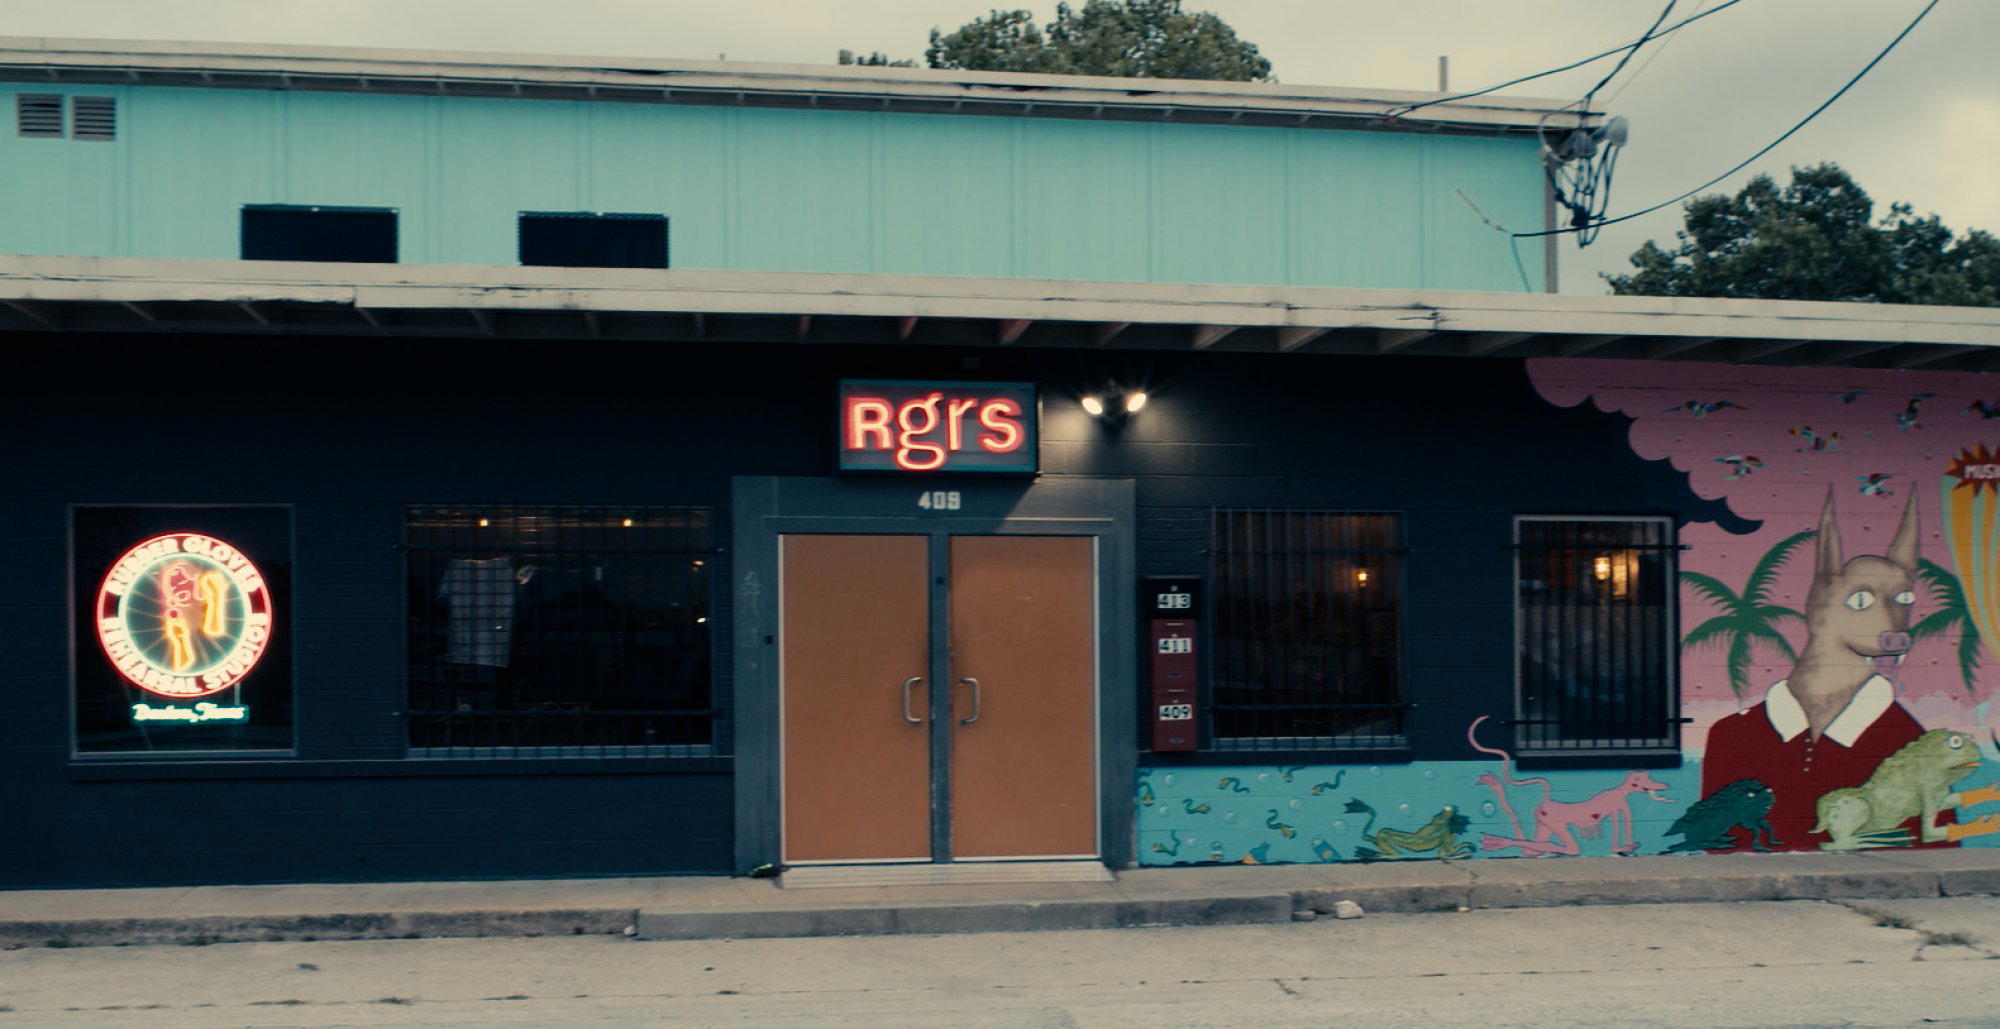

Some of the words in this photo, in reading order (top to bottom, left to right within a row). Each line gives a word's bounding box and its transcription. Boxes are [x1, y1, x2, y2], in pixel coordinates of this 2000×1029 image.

[845, 392, 1024, 470] Rgrs
[918, 491, 961, 510] 409
[182, 537, 262, 592] GLOVES
[1158, 594, 1191, 608] 413
[1159, 638, 1192, 653] 411
[1160, 706, 1192, 720] 409
